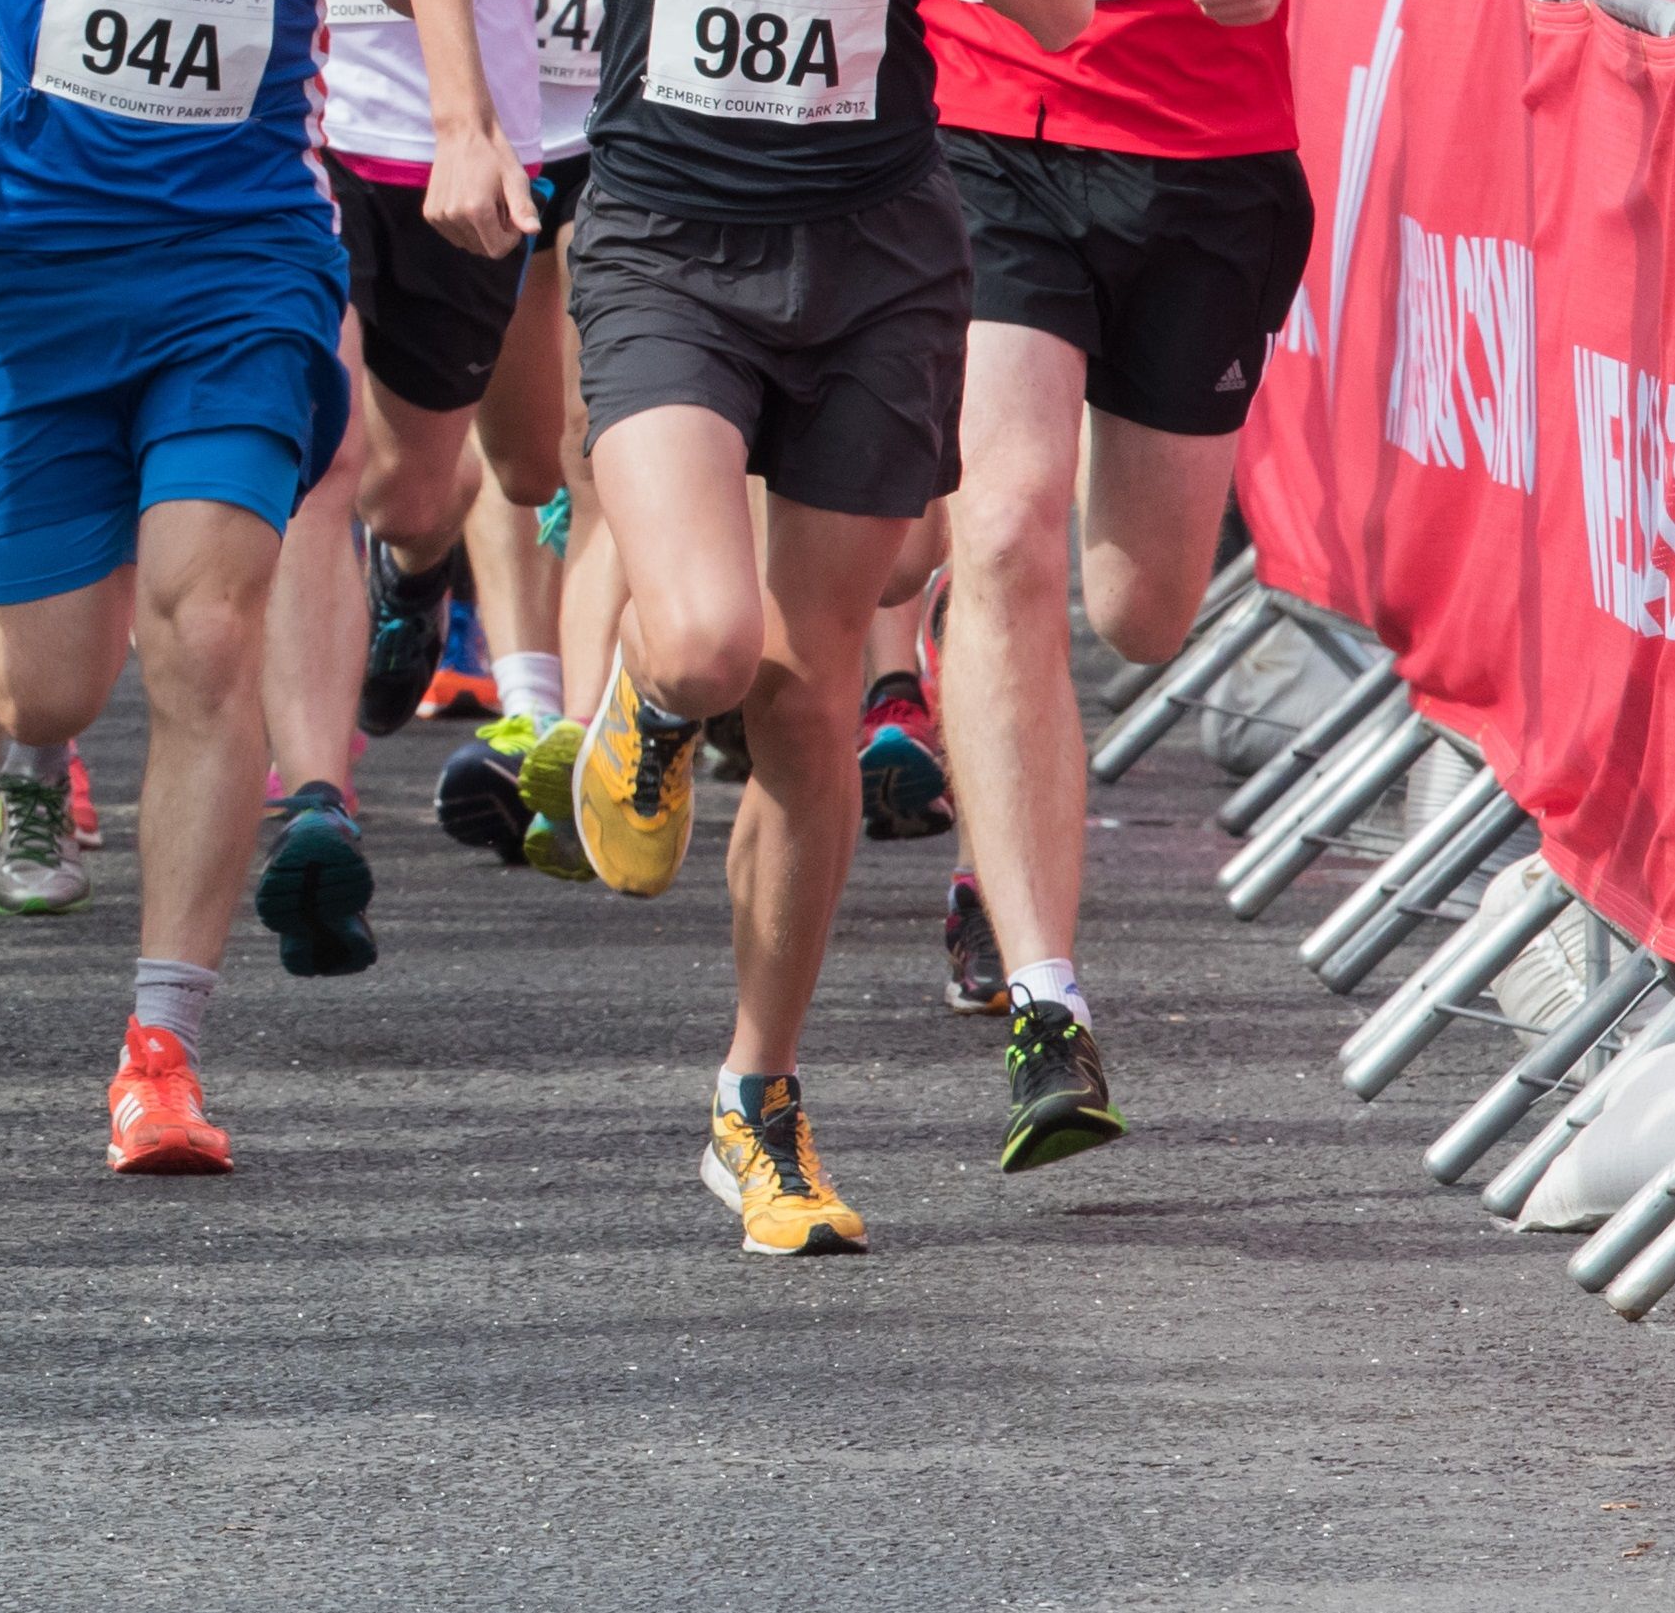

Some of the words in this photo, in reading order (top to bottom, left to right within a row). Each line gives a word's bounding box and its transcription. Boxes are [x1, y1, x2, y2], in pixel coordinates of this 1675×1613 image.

[82, 9, 221, 92] 94A
[694, 6, 839, 88] 98A
[45, 75, 107, 103] PEMBREY
[110, 96, 174, 117] COUNTRY
[177, 106, 212, 118] PARK
[215, 106, 243, 118] 2017
[656, 85, 721, 110] PEMBREY
[725, 99, 794, 116] COUNTRY
[797, 104, 831, 118] PARK
